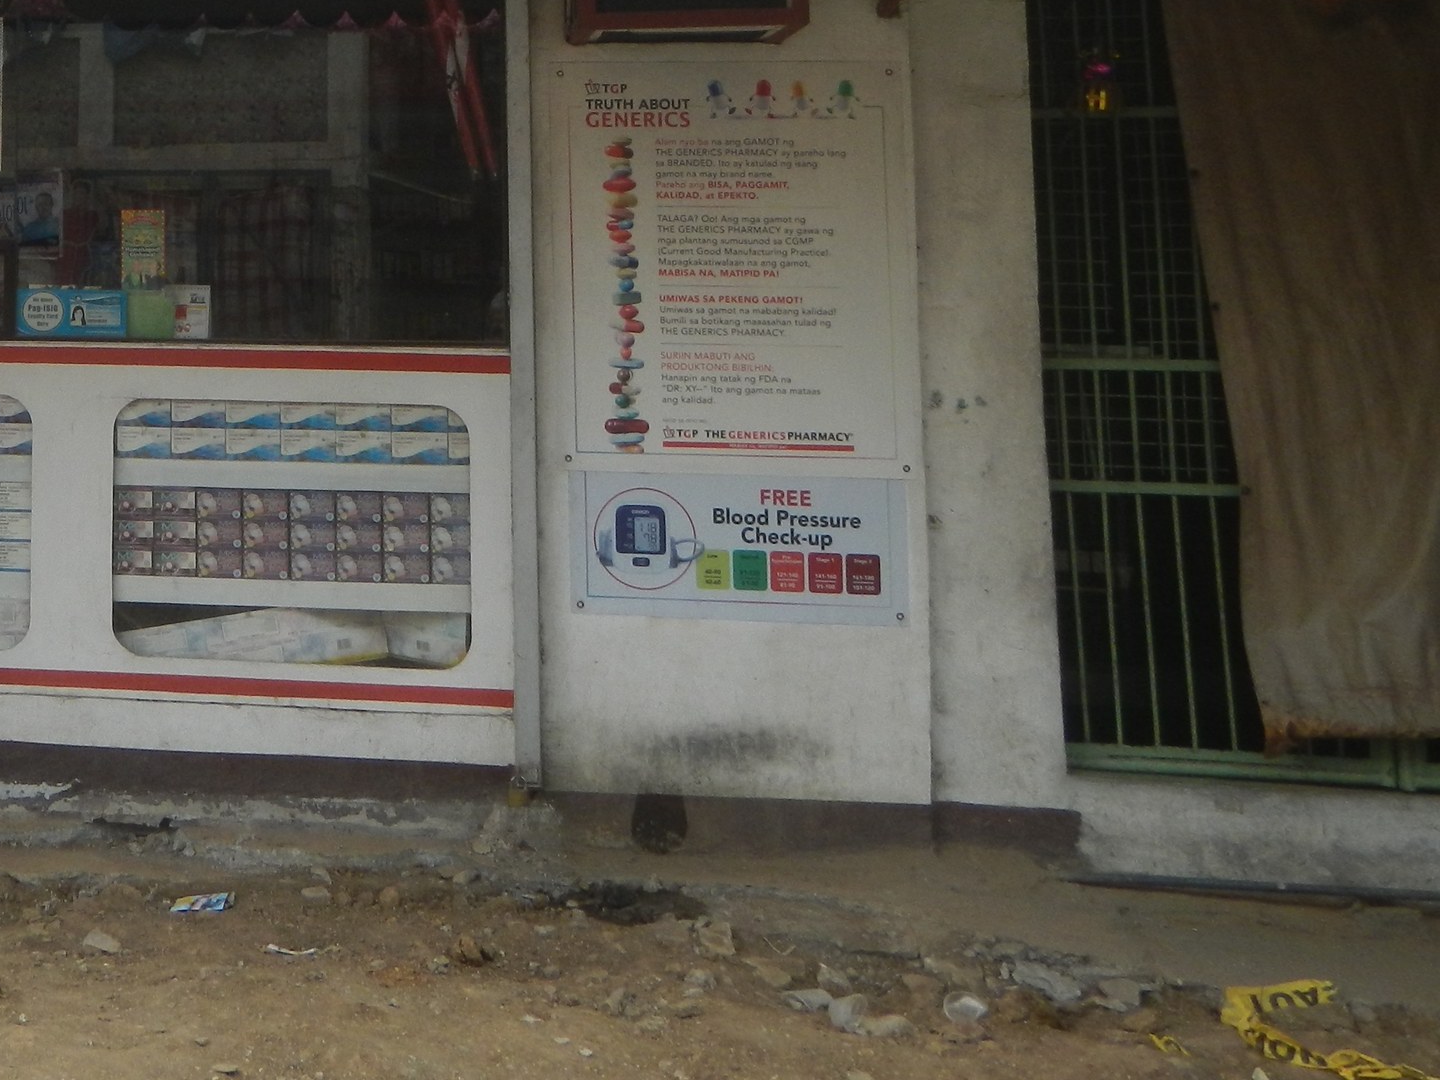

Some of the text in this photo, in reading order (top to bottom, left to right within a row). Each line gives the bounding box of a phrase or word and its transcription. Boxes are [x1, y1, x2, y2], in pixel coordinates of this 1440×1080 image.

[602, 84, 627, 93] TGP
[586, 99, 690, 110] TRUTH ABOUT
[586, 112, 690, 128] GENERICS
[743, 138, 780, 146] GAMOT
[656, 148, 673, 156] THE
[675, 148, 723, 156] GENERICS
[725, 149, 778, 157] PHARMACY
[708, 181, 732, 190] BISA,
[736, 181, 790, 189] PAGGAMIT,
[656, 191, 759, 200] KALIDAD, EPEKTO.
[657, 225, 675, 233] THE
[678, 225, 725, 233] GENERICS
[728, 226, 781, 234] PHARMACY
[696, 247, 721, 255] Good
[724, 248, 788, 257] Manufacturing
[659, 269, 780, 278] MABISA NA, MATIPID PA!
[659, 295, 700, 303] UMIWAS
[719, 296, 759, 304] PEKENG
[762, 296, 803, 304] GAMOT!
[659, 306, 693, 314] Umiwas
[681, 328, 728, 336] GENERICS
[731, 328, 785, 337] PHARMACY
[695, 352, 731, 360] MABUTI
[734, 352, 755, 361] ANG
[661, 362, 729, 371] PRODUKTONG
[661, 374, 697, 383] Hanapin
[758, 375, 778, 383] FDA
[676, 429, 850, 442] TGP THE GENERICS PHARMACY
[760, 489, 811, 506] FREE
[713, 507, 861, 528] Blood Pressure
[741, 527, 833, 550] Check-up
